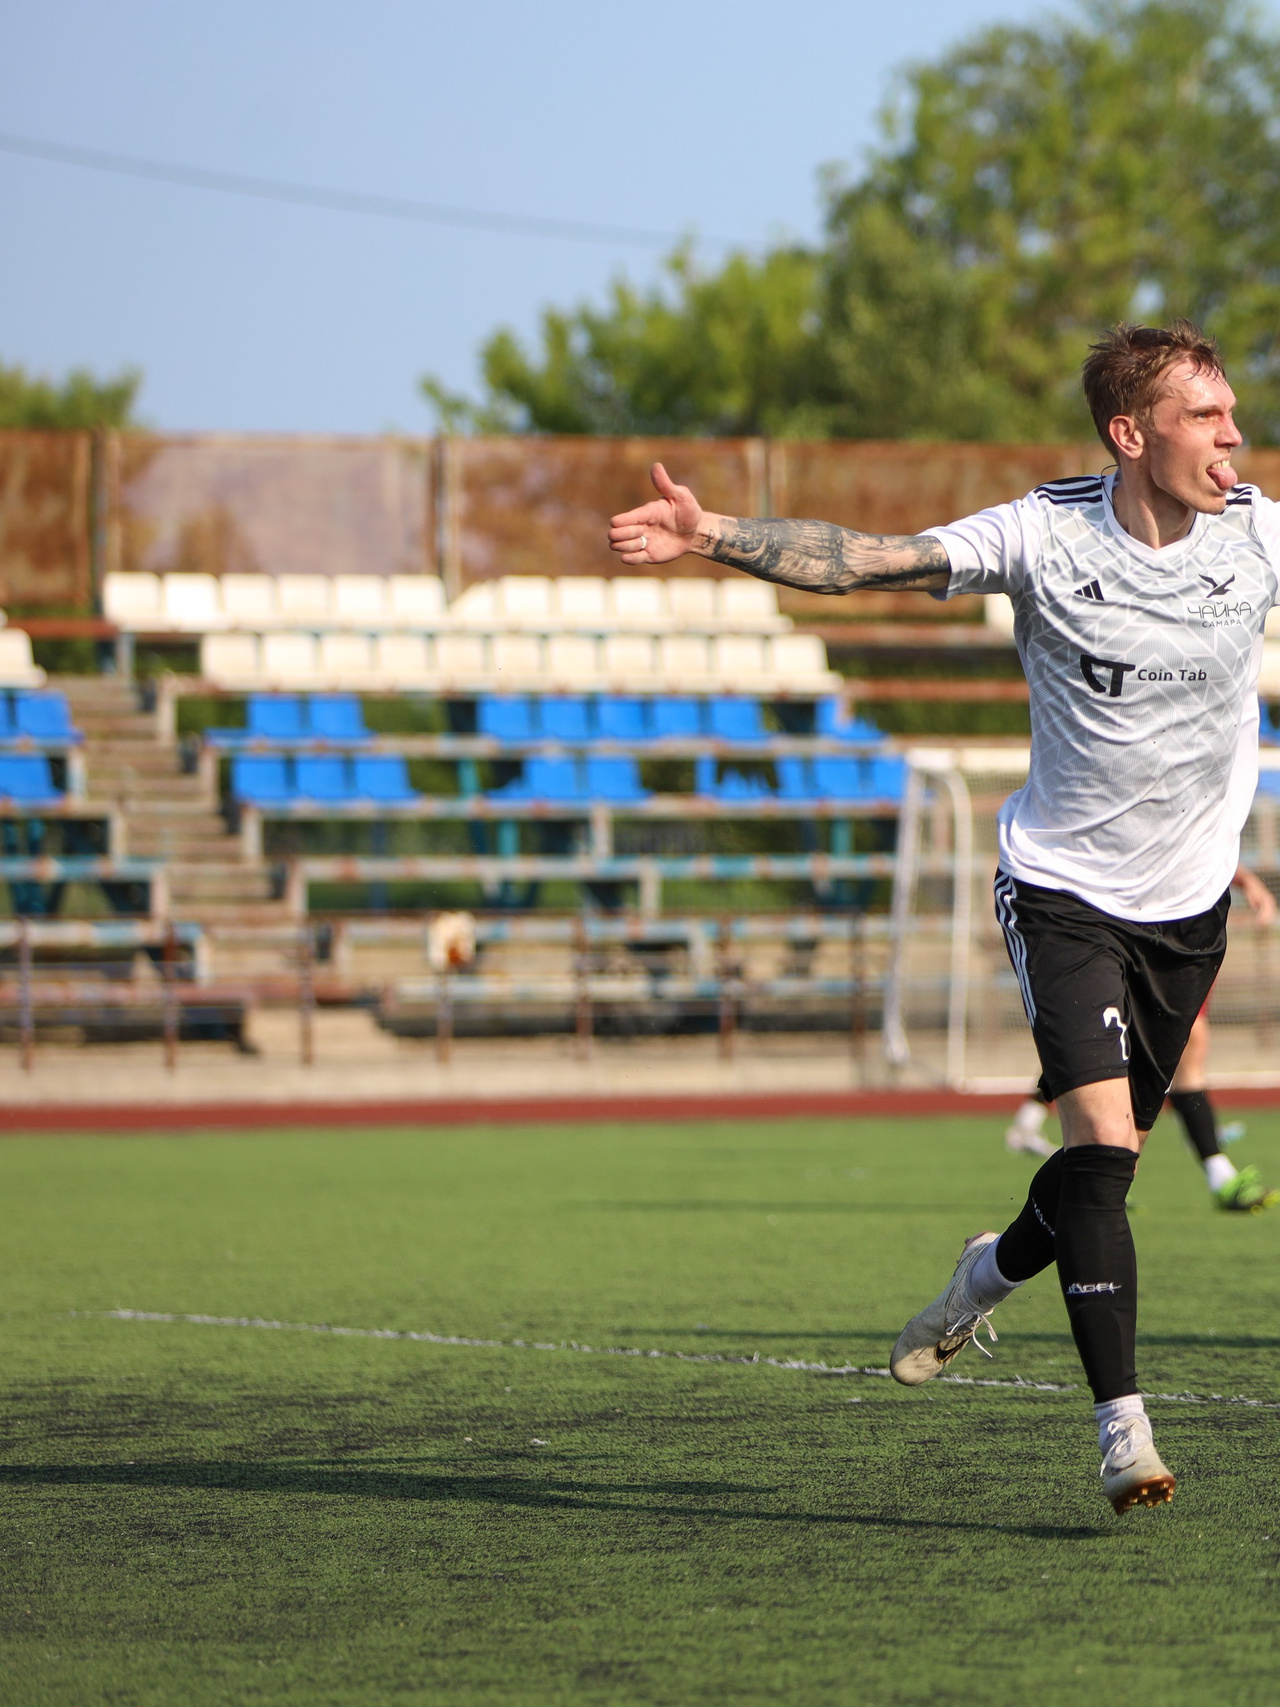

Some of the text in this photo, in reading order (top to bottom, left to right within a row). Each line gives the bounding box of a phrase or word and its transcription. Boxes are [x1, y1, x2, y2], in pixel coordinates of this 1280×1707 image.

[1187, 601, 1252, 618] ЧАЙКА
[1201, 619, 1242, 628] САМАРА
[1137, 668, 1207, 681] Coin Tab
